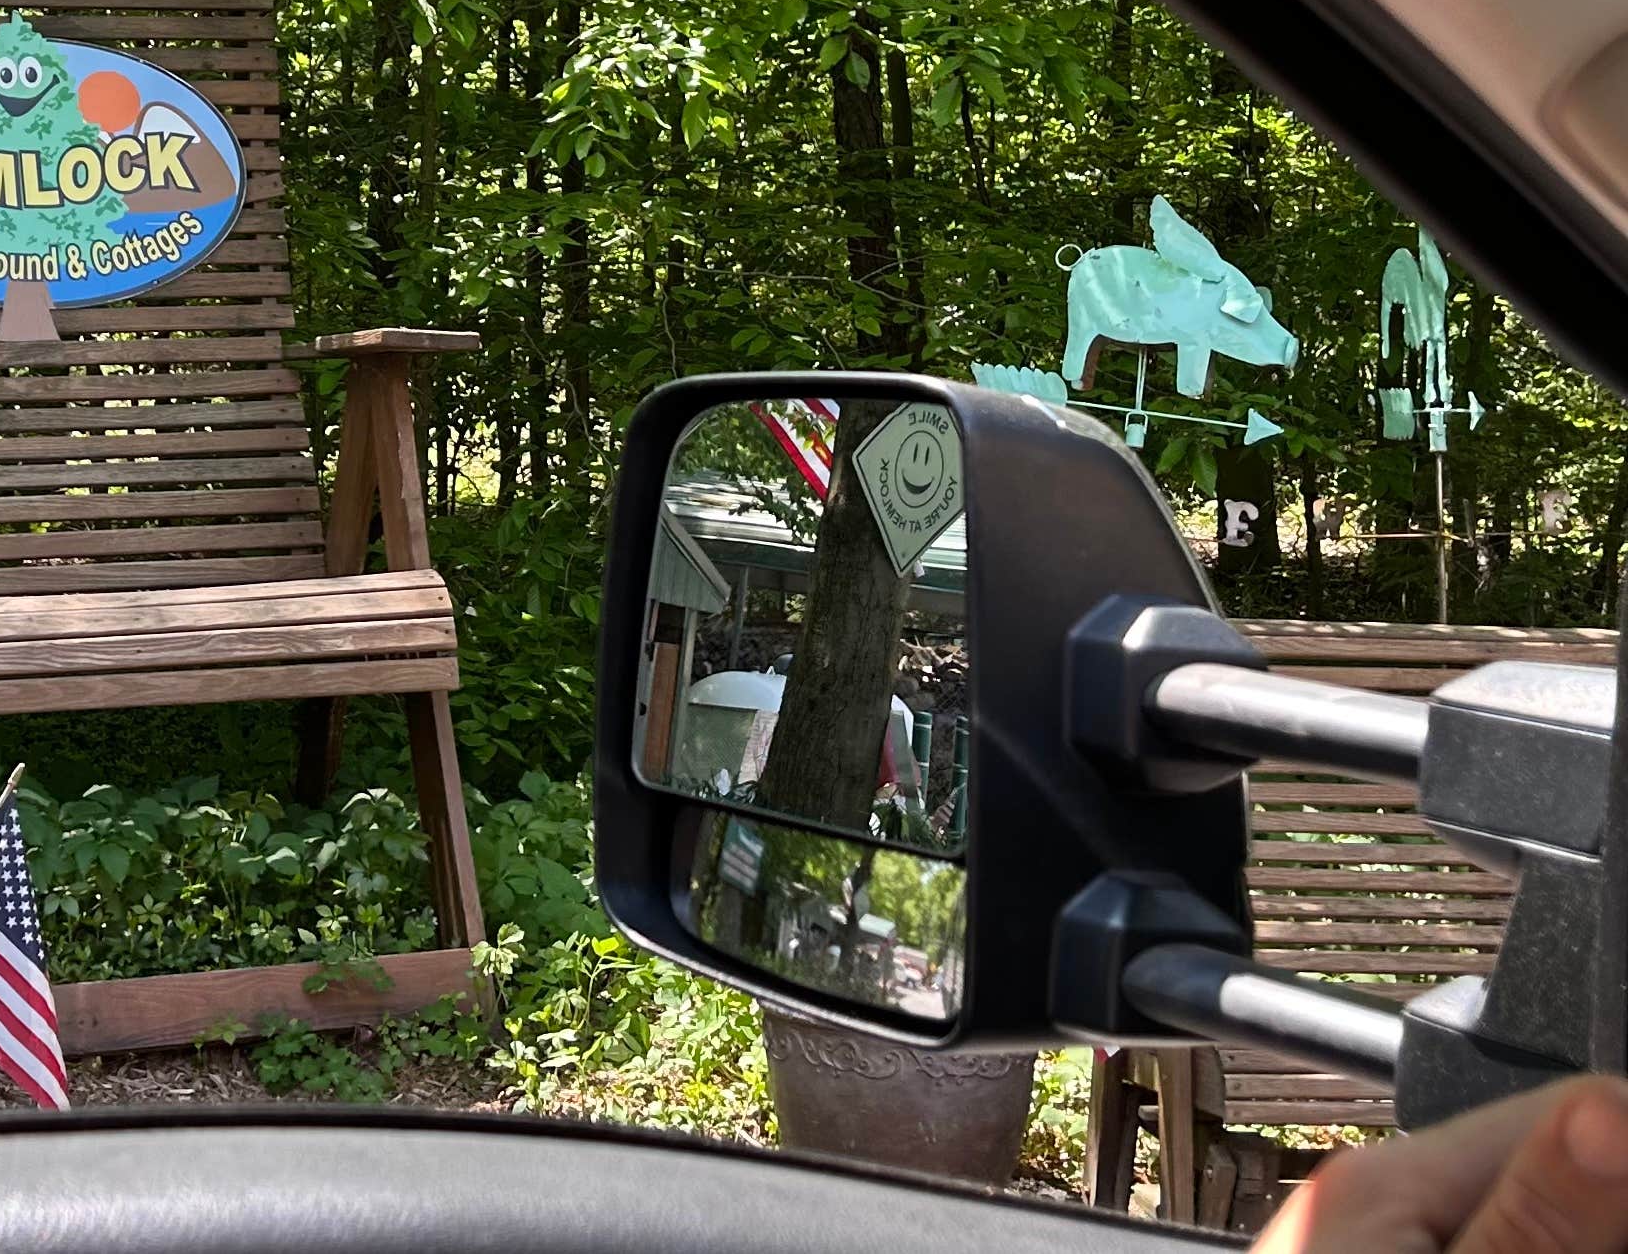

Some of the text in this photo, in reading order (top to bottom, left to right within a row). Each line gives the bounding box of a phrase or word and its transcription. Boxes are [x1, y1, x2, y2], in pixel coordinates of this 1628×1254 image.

[65, 245, 87, 279] &
[91, 212, 202, 275] Cottages
[1222, 499, 1259, 547] E
